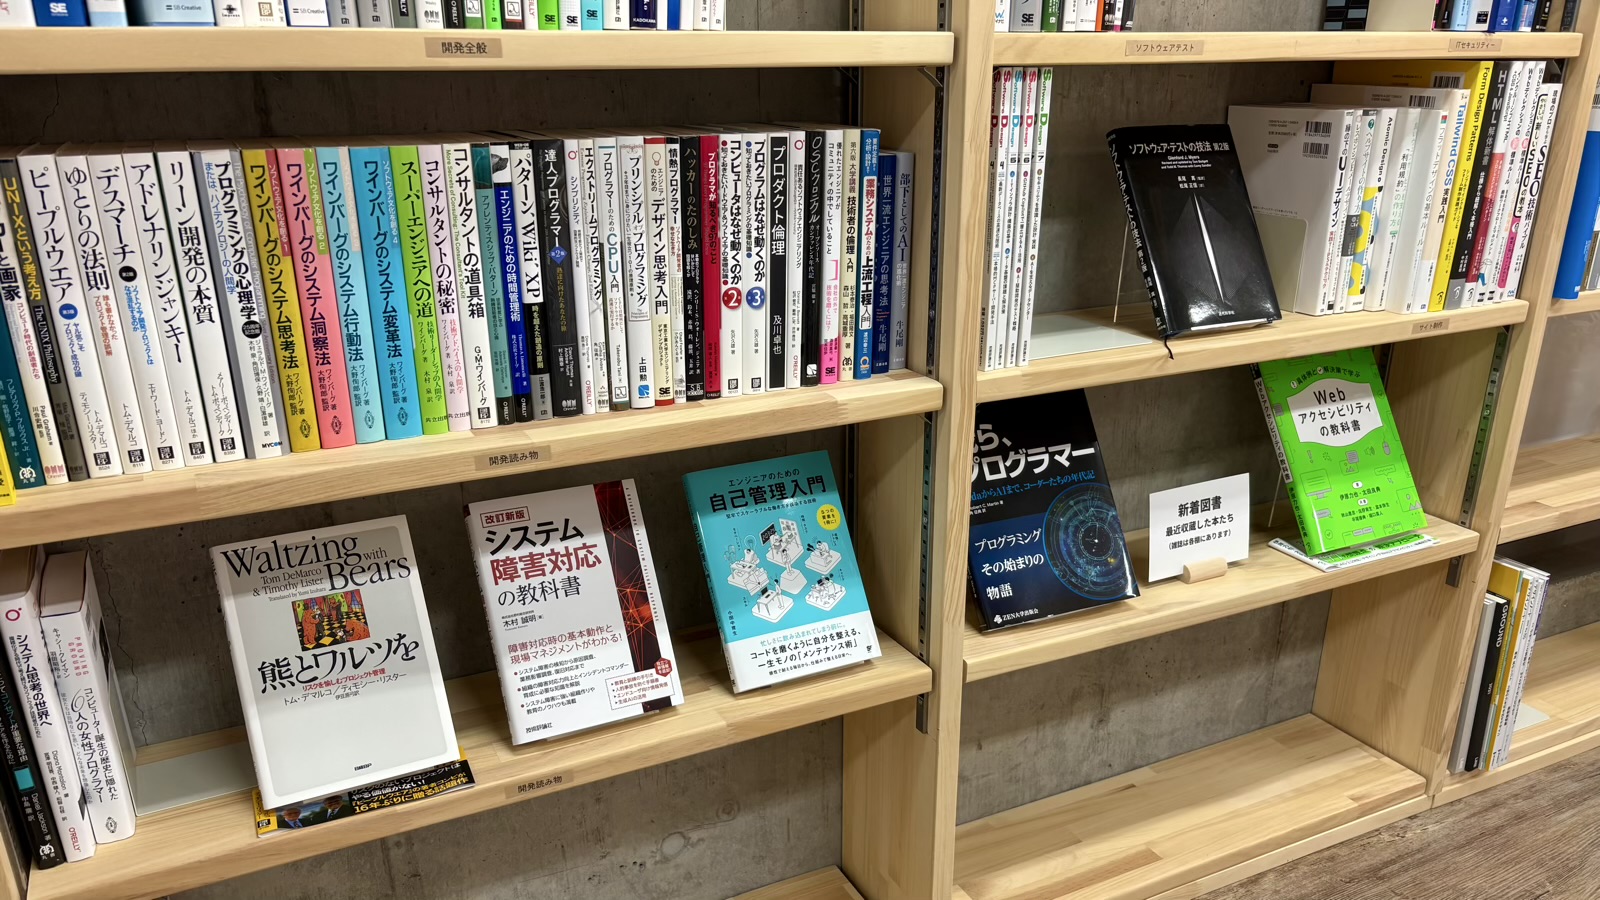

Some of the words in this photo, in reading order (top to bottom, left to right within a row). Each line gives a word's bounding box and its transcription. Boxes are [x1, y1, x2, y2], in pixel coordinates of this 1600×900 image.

[441, 41, 488, 55] 開発全般
[1135, 43, 1195, 53] ソフトウェアテスト
[1455, 41, 1495, 49] ITセキュリティー
[1012, 69, 1023, 114] Software
[1025, 69, 1037, 114] Software
[1040, 68, 1052, 112] Software
[1481, 67, 1491, 91] Form
[1474, 93, 1485, 126] Design
[1010, 115, 1020, 148] Design
[1023, 115, 1034, 148] Design
[1037, 113, 1049, 146] Design
[1128, 141, 1212, 155] ソフトウェア・テストの技法
[1383, 116, 1393, 148] Atomic
[1449, 102, 1467, 157] Tailwind
[1466, 125, 1479, 162] Patterns
[808, 136, 823, 224] OSCクロニクル
[1378, 148, 1388, 176] Design
[1443, 159, 1456, 187] CSS
[544, 149, 563, 247] 達人プログラマー
[570, 176, 579, 225] シンプリシティ
[668, 148, 680, 224] 情熱プログラマー
[684, 148, 698, 250] ハッカーのたのしみ
[771, 145, 786, 256] プロダクト倫理
[826, 143, 835, 255] コミュニティの中でしていること
[1437, 187, 1450, 223] 実践入門
[1519, 145, 1548, 249] SEO技術バイブル
[96, 166, 136, 265] デスマーチ
[584, 147, 602, 300] エクストリームプログラミング
[603, 152, 619, 293] プログラマーのためのCPU入門
[707, 153, 718, 264] プログラマが知るべき97のこと
[730, 140, 742, 286] コンピュータはなぜ動くのか
[754, 141, 766, 283] プログラムはなぜ動くのか
[846, 196, 857, 255] 技術者の倫理
[897, 172, 911, 262] 部下としてのAI
[3, 177, 41, 300] UNIXという考え方
[29, 166, 73, 302] ピープルウエア
[64, 166, 110, 292] ゆとりの法則
[170, 161, 215, 324] リーン開発の本質
[214, 161, 257, 320] プログラミングの心理学
[400, 161, 433, 319] スーパーエンジニアへの道
[425, 160, 455, 315] コンサルタントの秘密
[454, 149, 484, 319] コンサルタントの道具箱
[879, 175, 893, 306] 世界一流エンジニアの思考法
[130, 164, 186, 363] アドレナリンジャンキー
[250, 165, 299, 370] ワインバーグのシステム思考法
[287, 163, 332, 366] ワインバーグのシステム洞察法
[323, 161, 364, 362] ワインバーグのシステム行動法
[364, 161, 402, 359] ワインバーグのシステム変革法
[500, 190, 521, 322] エンジニアのための時間管理術
[651, 199, 669, 315] デザイン思考入門
[846, 257, 853, 273] 入門
[860, 178, 875, 328] 業務システムのための上流工程入門
[773, 315, 782, 355] 及川卓也
[878, 325, 887, 352] 牛尾剛
[895, 320, 904, 348] 牛尾剛
[825, 366, 835, 374] SE
[659, 387, 671, 395] SE
[1313, 387, 1346, 405] Web
[1297, 402, 1372, 425] アクセシビリティ
[1319, 419, 1361, 437] の教科書
[973, 424, 1012, 453] ら、
[488, 451, 539, 466] 開発読み物
[728, 468, 800, 487] エンジニアのための
[708, 474, 828, 513] 自己管理入門
[1177, 495, 1222, 518] 新着図書
[484, 509, 526, 525] 改訂新版
[1165, 513, 1234, 537] 最近収蔵した本たち
[362, 547, 388, 562] with
[485, 518, 585, 556] システム
[974, 528, 1042, 553] プログラミング
[220, 535, 359, 579] Waltzing
[323, 555, 412, 592] Bears
[489, 543, 602, 586] 障害対応
[981, 553, 1045, 576] その始まりの
[252, 587, 261, 597] &
[261, 581, 299, 597] Timothy
[300, 577, 324, 590] Lister
[260, 574, 281, 586] Tom
[283, 567, 322, 583] DeMarco
[497, 575, 582, 607] の教科書
[985, 583, 1013, 600] 物語
[503, 617, 519, 628] 木村
[1002, 607, 1039, 621] ZEN大学出版会
[1495, 604, 1509, 648] GROUND
[507, 624, 614, 654] 障害対応時の基本動作と
[509, 633, 623, 665] 現場マネジメントがわかる!
[750, 628, 862, 660] コードを磨くように自分を整える、
[757, 638, 858, 669] 一生モノの「メンテナンス術」
[16, 634, 53, 727] システム思考の世界へ
[257, 633, 420, 694] 熊とワルツを
[302, 668, 386, 692] リスクを愉しむプロジェクト管理
[71, 688, 103, 803] 6人の女性プログラマー
[517, 775, 563, 793] 開発読み物
